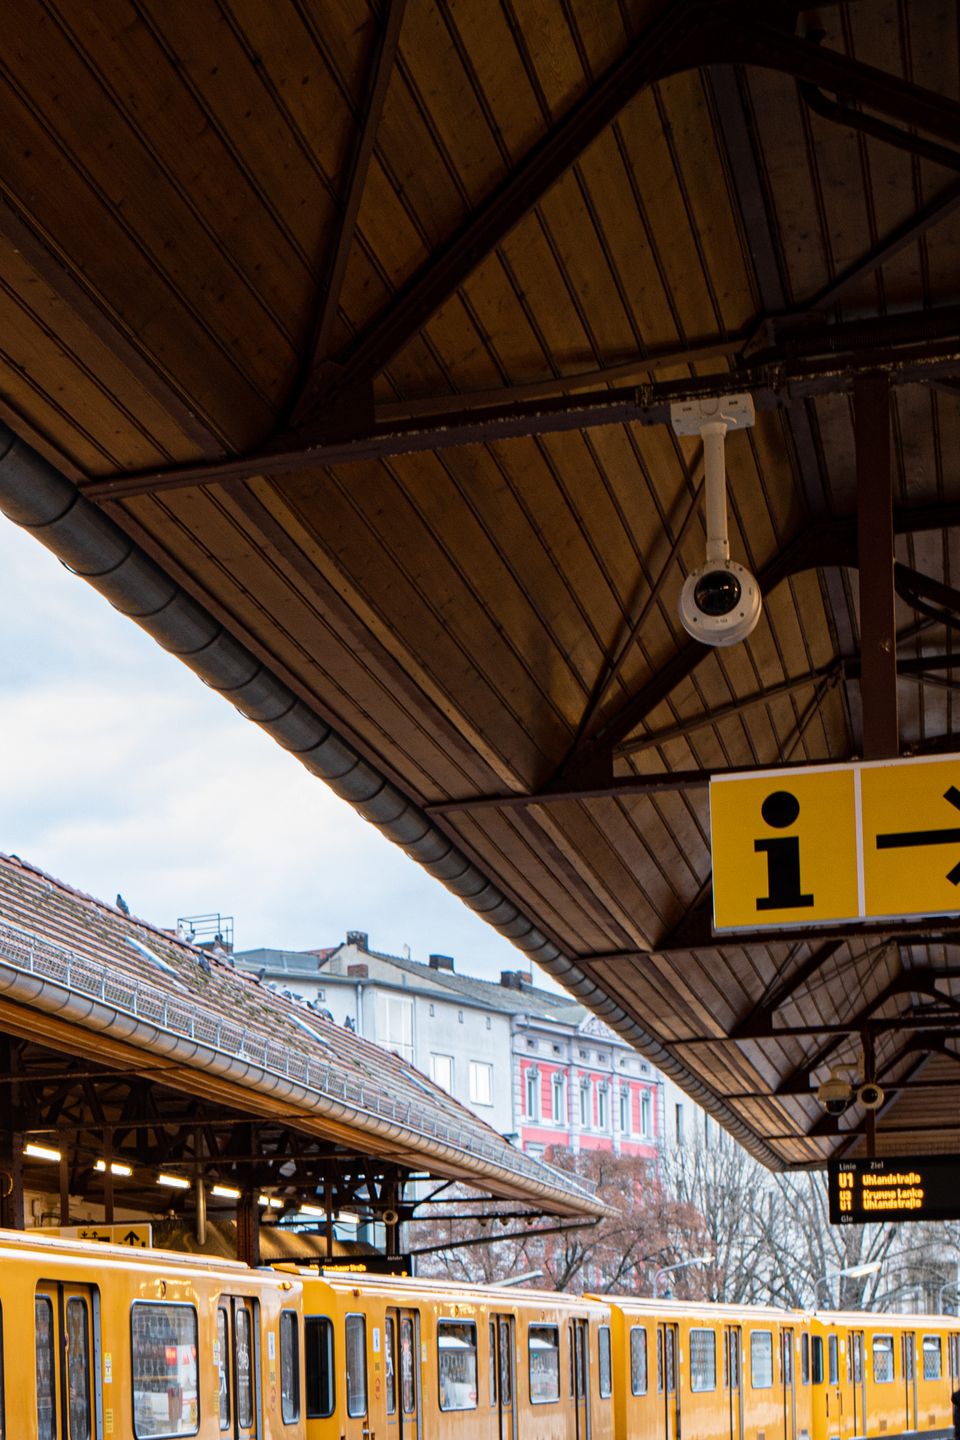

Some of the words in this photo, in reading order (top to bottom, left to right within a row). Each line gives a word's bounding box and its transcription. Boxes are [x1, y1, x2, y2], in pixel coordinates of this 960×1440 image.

[754, 790, 814, 911] i
[839, 1162, 857, 1171] Linie
[870, 1161, 884, 1170] Ziel
[838, 1172, 854, 1188] U1
[862, 1172, 921, 1186] Uhlandstraße
[897, 1187, 924, 1199] Lanke
[839, 1200, 852, 1211] U1
[863, 1198, 922, 1210] Uhlandstraße
